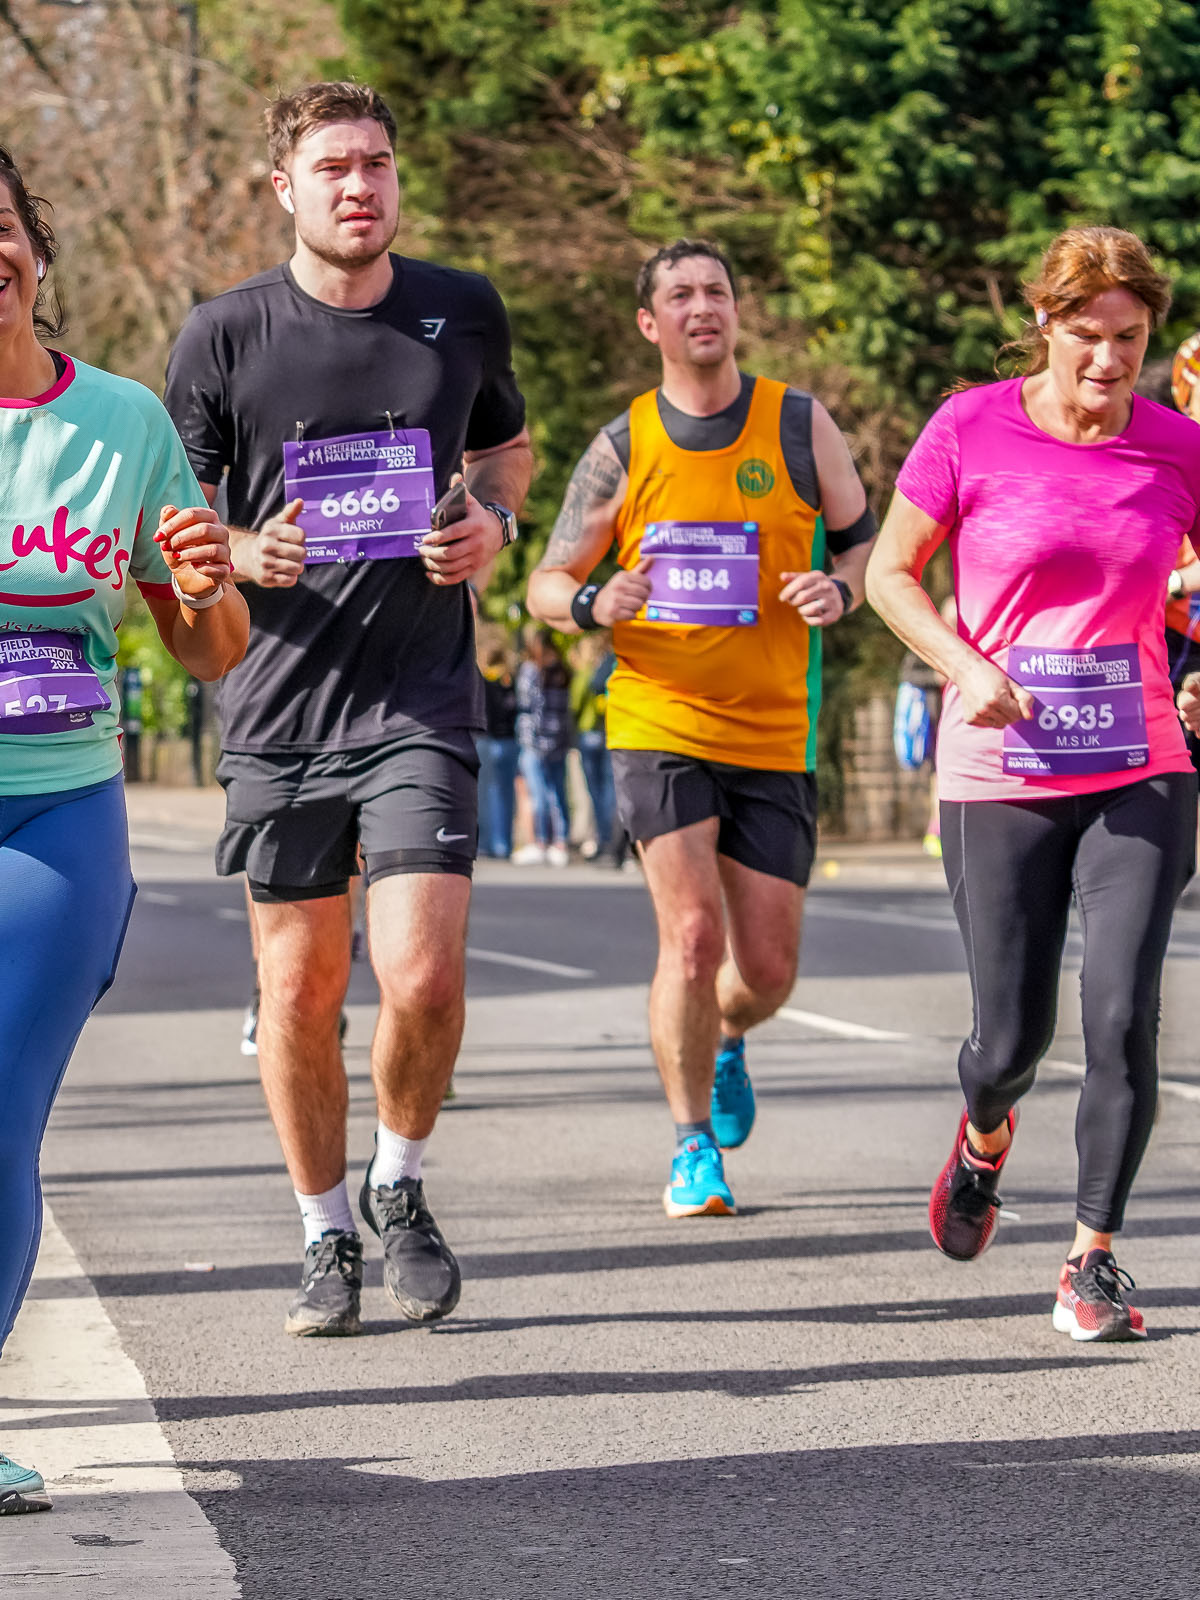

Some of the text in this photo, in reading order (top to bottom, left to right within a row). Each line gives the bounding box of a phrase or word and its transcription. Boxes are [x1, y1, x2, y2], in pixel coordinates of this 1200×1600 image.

[325, 440, 373, 453] SHEFFIELD
[325, 446, 415, 462] HALF MARATHON
[387, 457, 417, 468] 2022
[321, 488, 400, 518] 6666
[340, 519, 384, 533] HARRY
[667, 567, 731, 591] 8884
[8, 647, 73, 663] MARATHON
[1048, 655, 1095, 665] SHEFFIELD
[50, 659, 79, 670] 2022
[1047, 661, 1129, 675] HALF MARATHON
[1105, 671, 1130, 684] 2022
[1038, 703, 1115, 731] 6935
[1056, 735, 1101, 746] M.S UK
